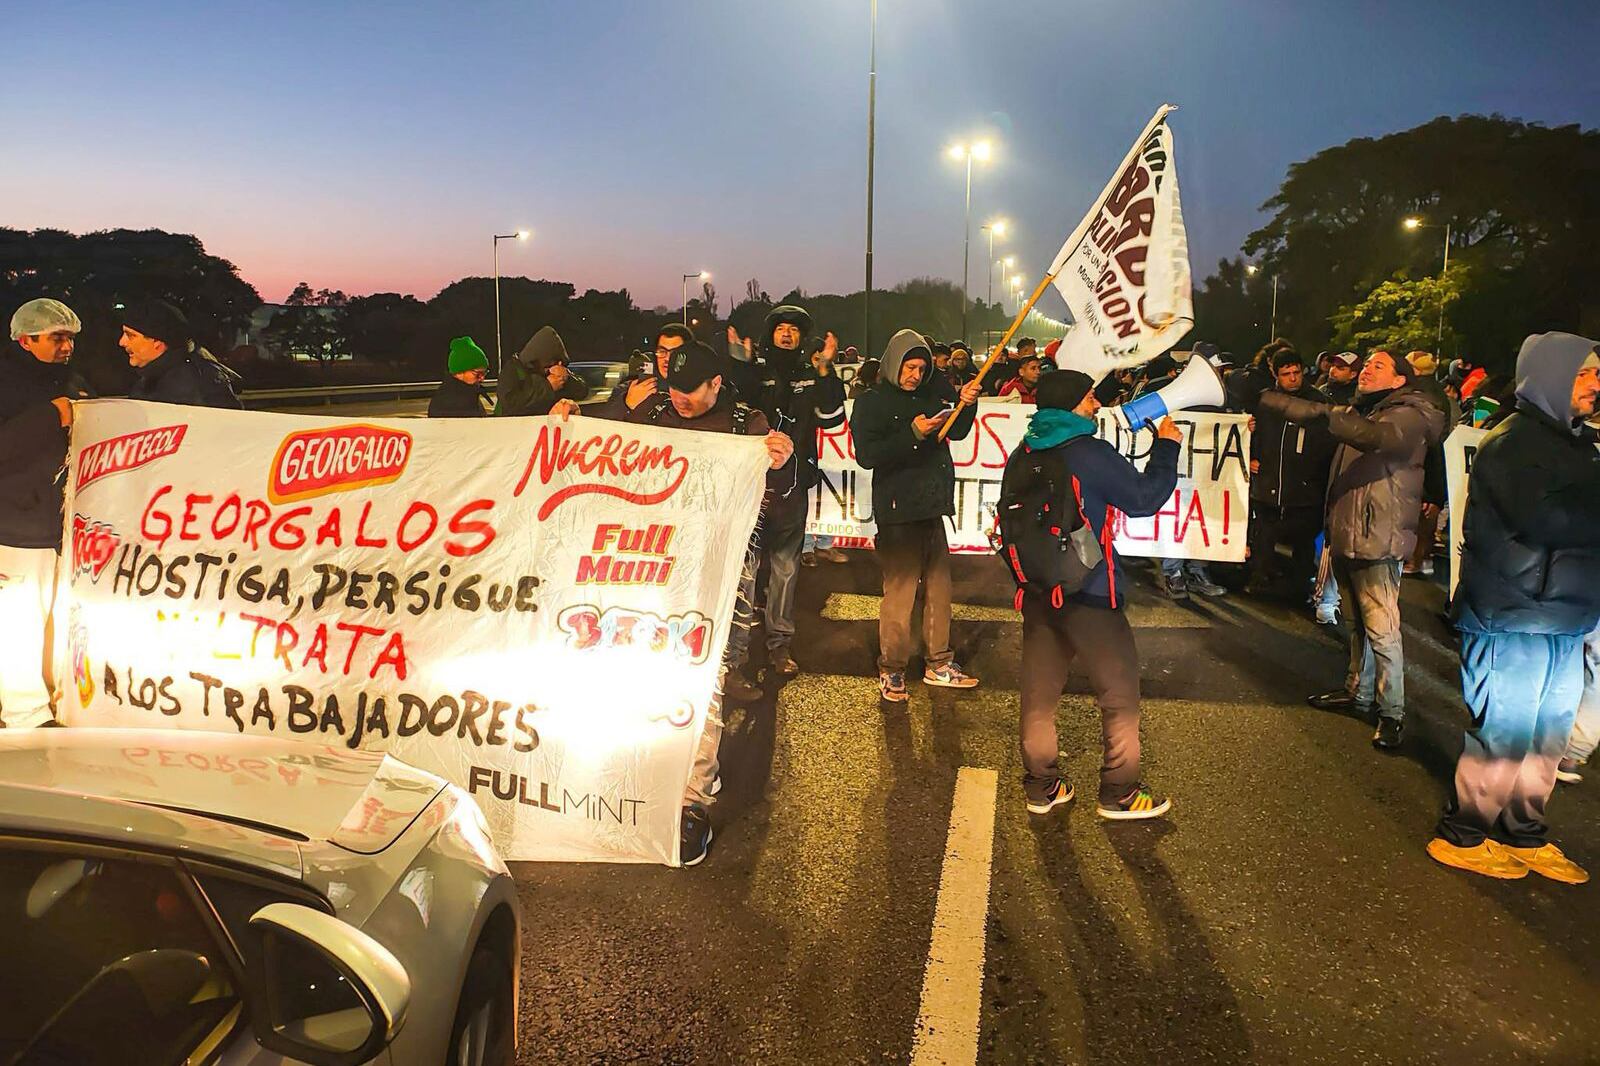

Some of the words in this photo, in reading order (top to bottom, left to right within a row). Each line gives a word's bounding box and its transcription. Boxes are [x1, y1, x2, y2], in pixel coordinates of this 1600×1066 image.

[80, 427, 180, 479] MANTECOL
[279, 435, 408, 485] GEORGALOS
[141, 485, 496, 557] GEORGALOS
[591, 523, 676, 556] Full
[127, 666, 182, 716] LOS
[189, 671, 541, 753] TRABAJADORES
